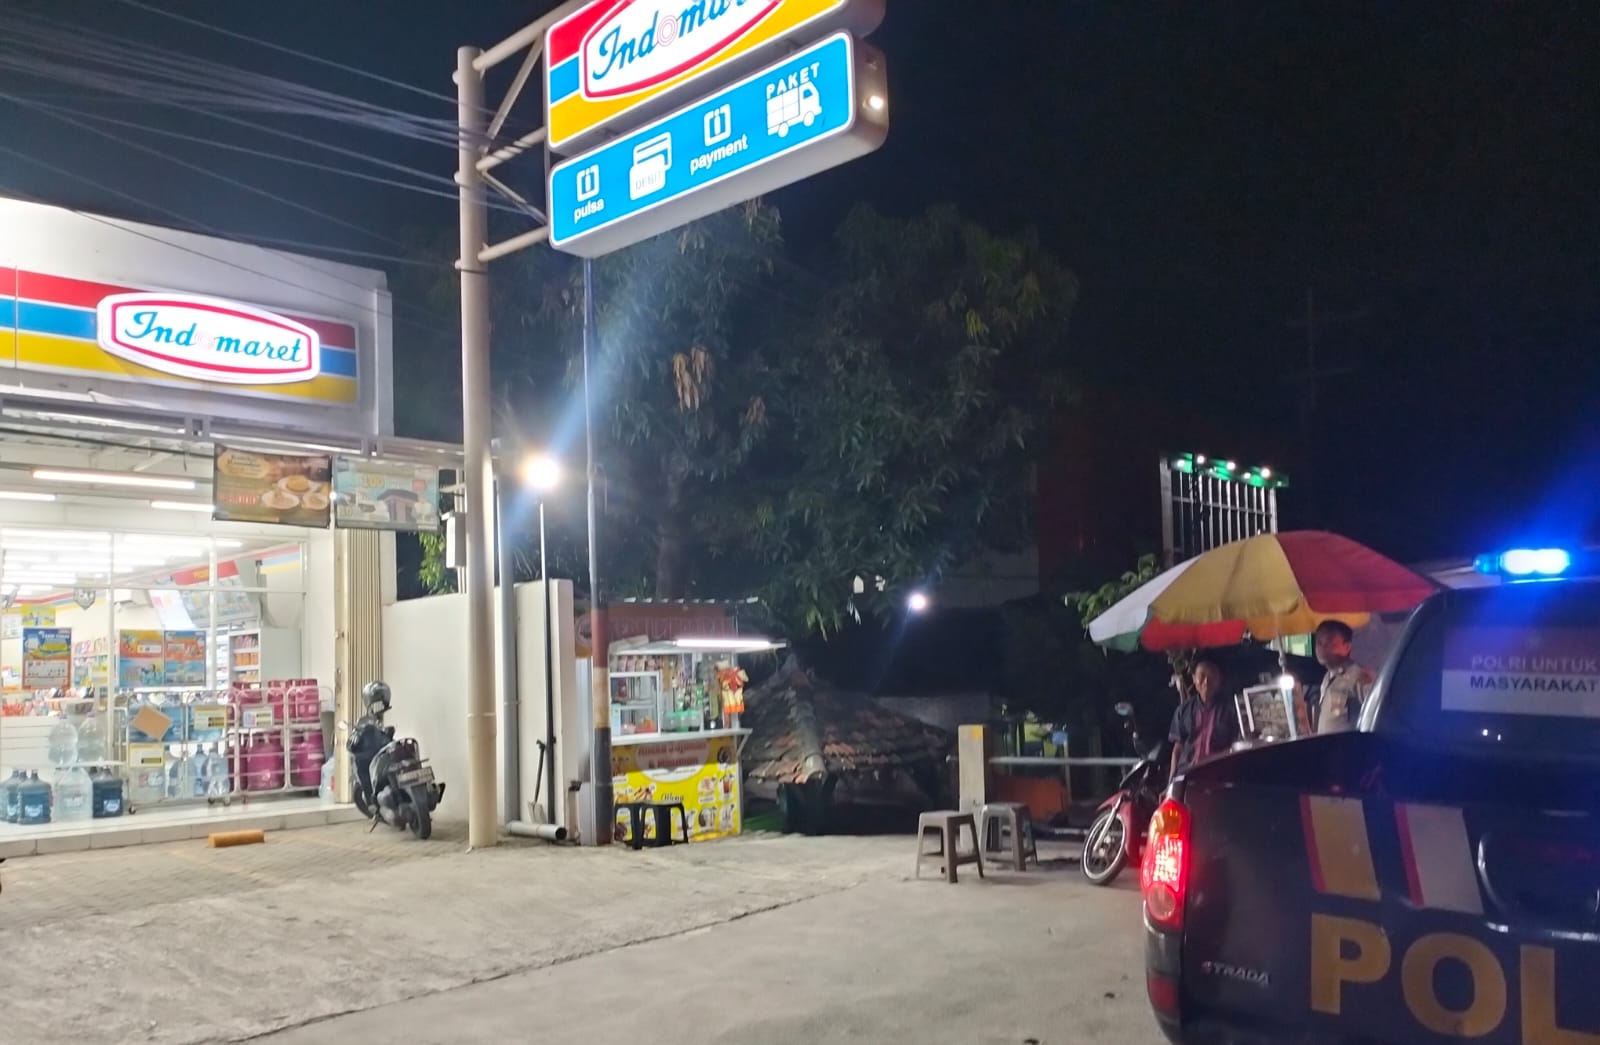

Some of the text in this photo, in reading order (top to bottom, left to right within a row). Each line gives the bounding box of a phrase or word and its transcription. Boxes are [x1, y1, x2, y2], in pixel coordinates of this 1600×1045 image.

[592, 0, 744, 81] Indoma
[766, 62, 821, 99] PAKET
[690, 133, 749, 176] payment
[573, 198, 605, 224] pulsa
[1471, 655, 1599, 673] POLRI UNTUK
[1470, 675, 1598, 693] MASYARAKAT
